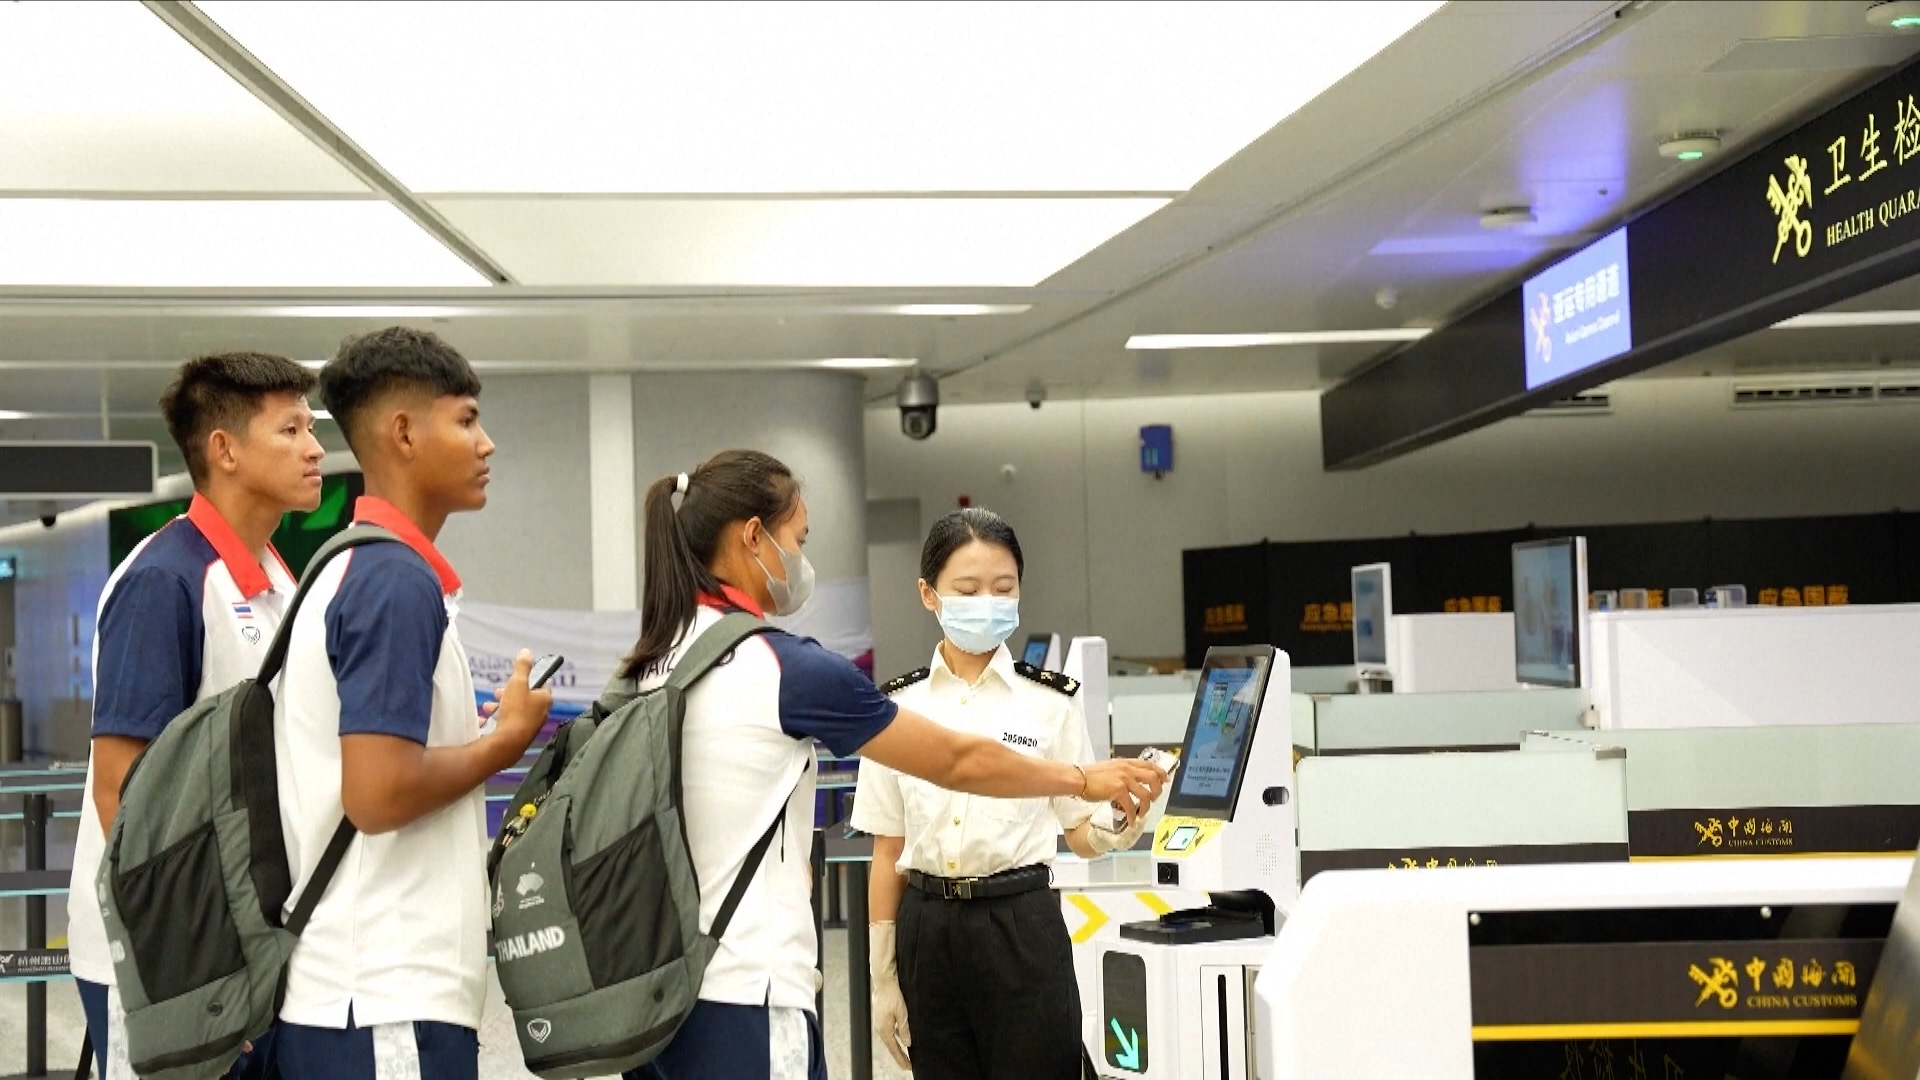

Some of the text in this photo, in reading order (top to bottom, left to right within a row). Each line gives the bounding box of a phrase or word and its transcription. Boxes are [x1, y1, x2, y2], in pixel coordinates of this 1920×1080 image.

[1826, 207, 1875, 248] HEALTH
[495, 925, 565, 963] THAILAND
[1746, 994, 1857, 1009] CHINA CUSTOMS
